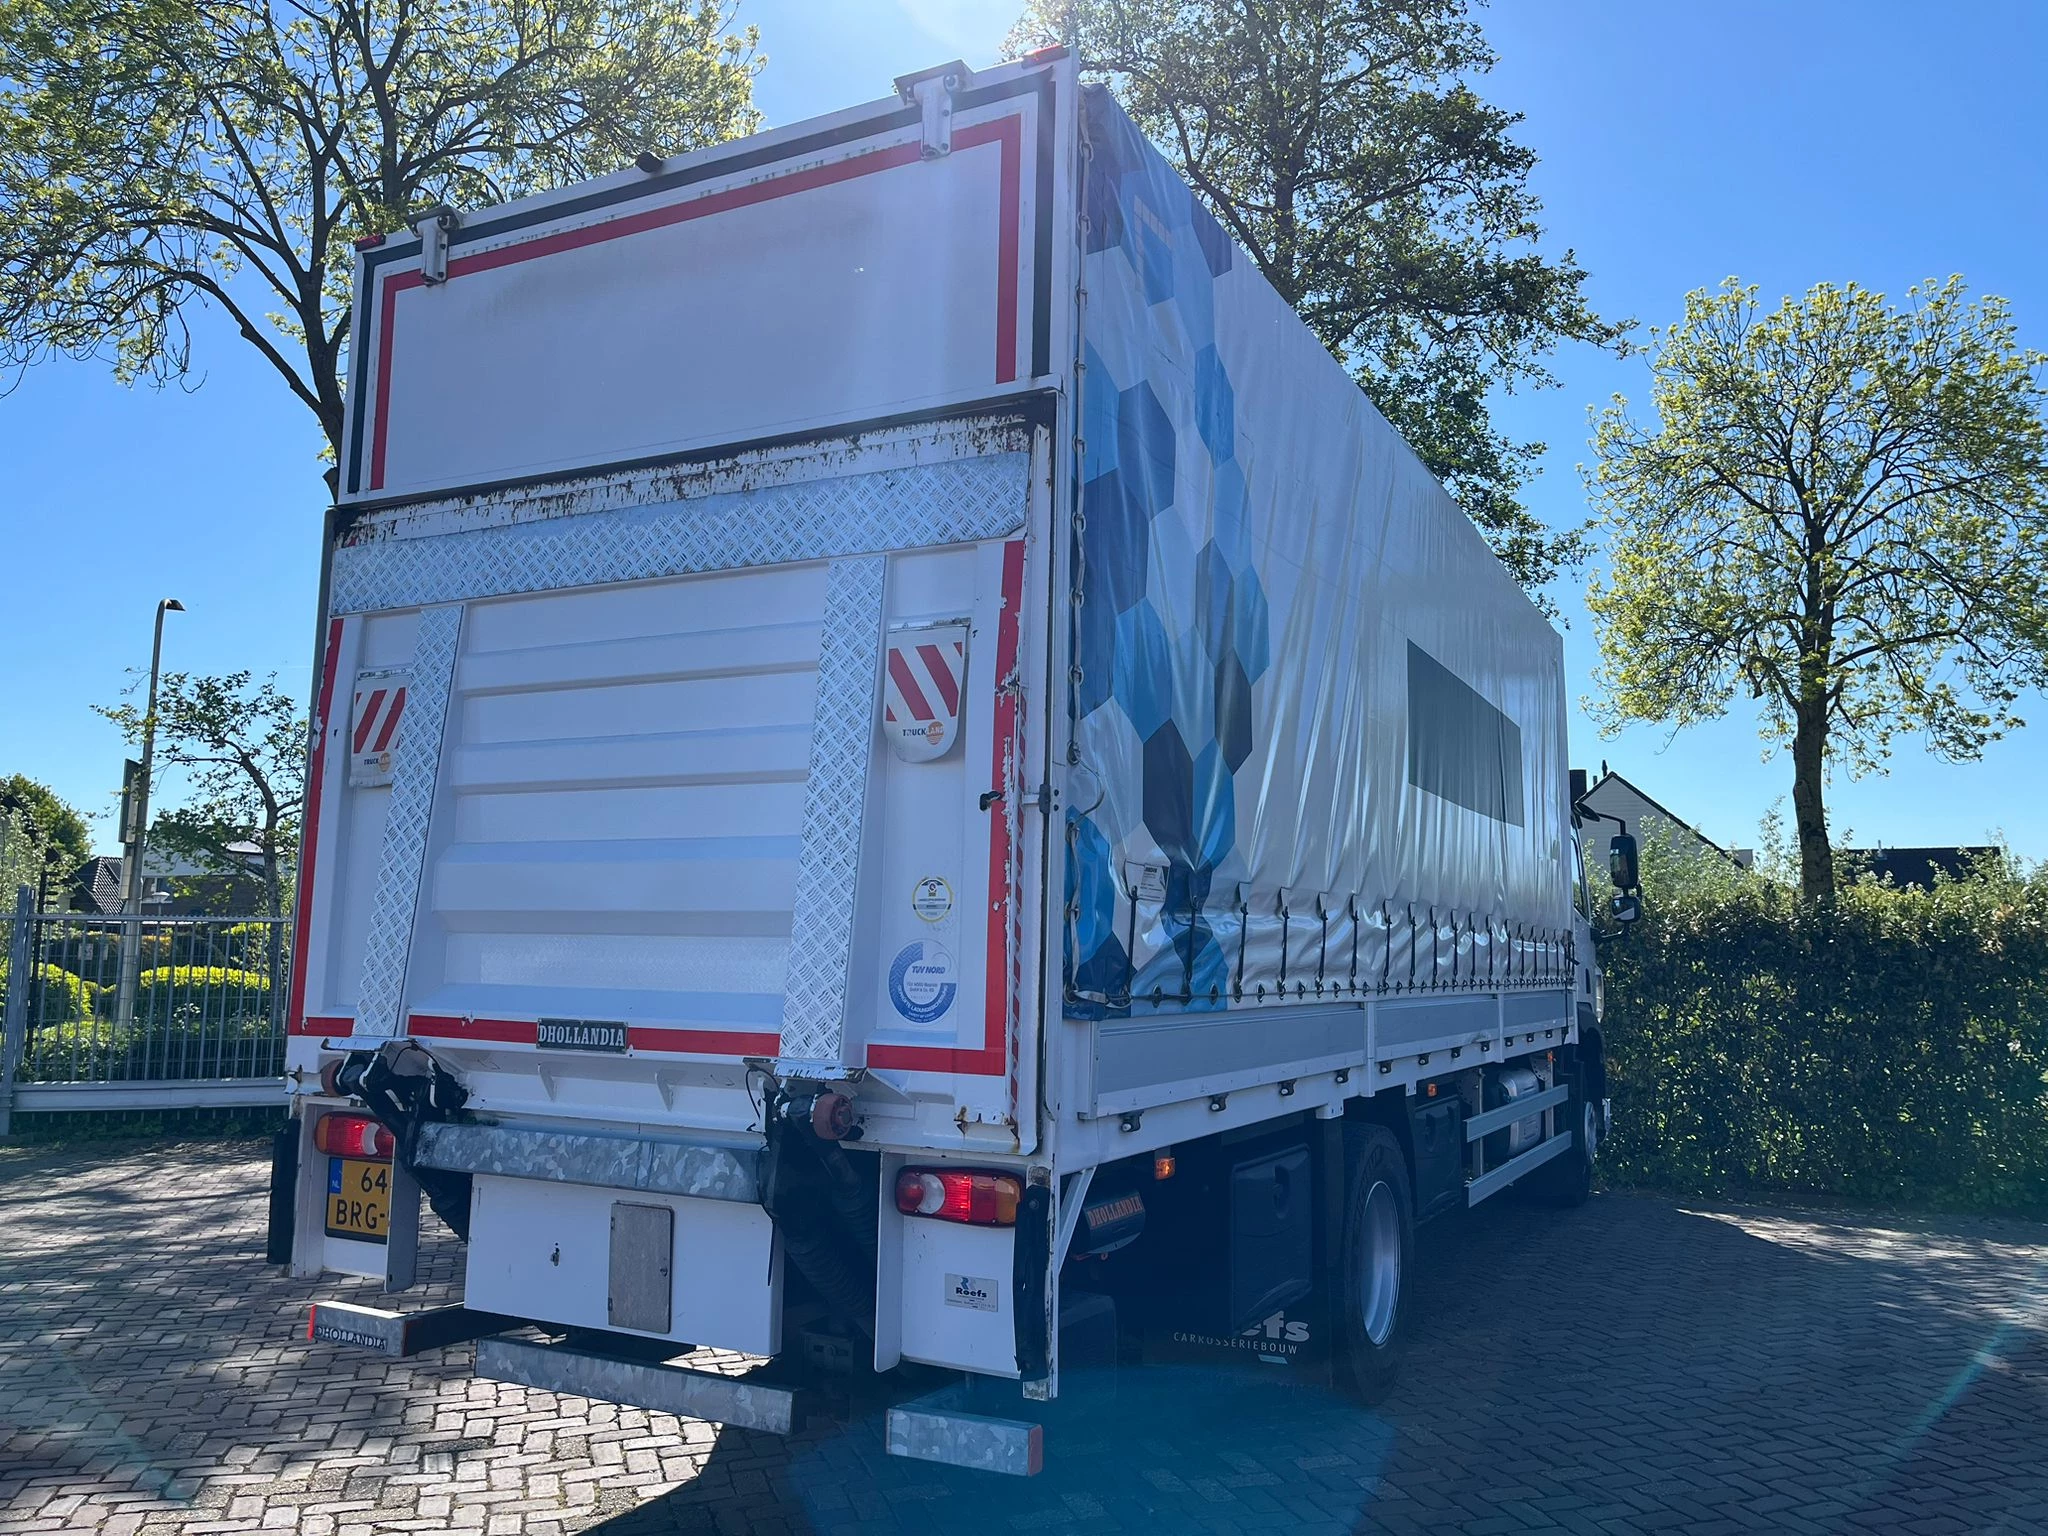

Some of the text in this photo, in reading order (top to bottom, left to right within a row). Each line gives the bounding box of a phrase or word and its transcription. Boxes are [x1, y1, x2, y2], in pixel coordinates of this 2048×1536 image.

[925, 966, 946, 975] NORD
[538, 1025, 625, 1047] DHOLLANDIA
[361, 1167, 388, 1194] 64
[336, 1199, 390, 1230] BRG-
[1086, 1195, 1143, 1228] DHOLLANDIA
[955, 1286, 987, 1298] Roefs
[315, 1326, 388, 1352] DHOLLANDIA
